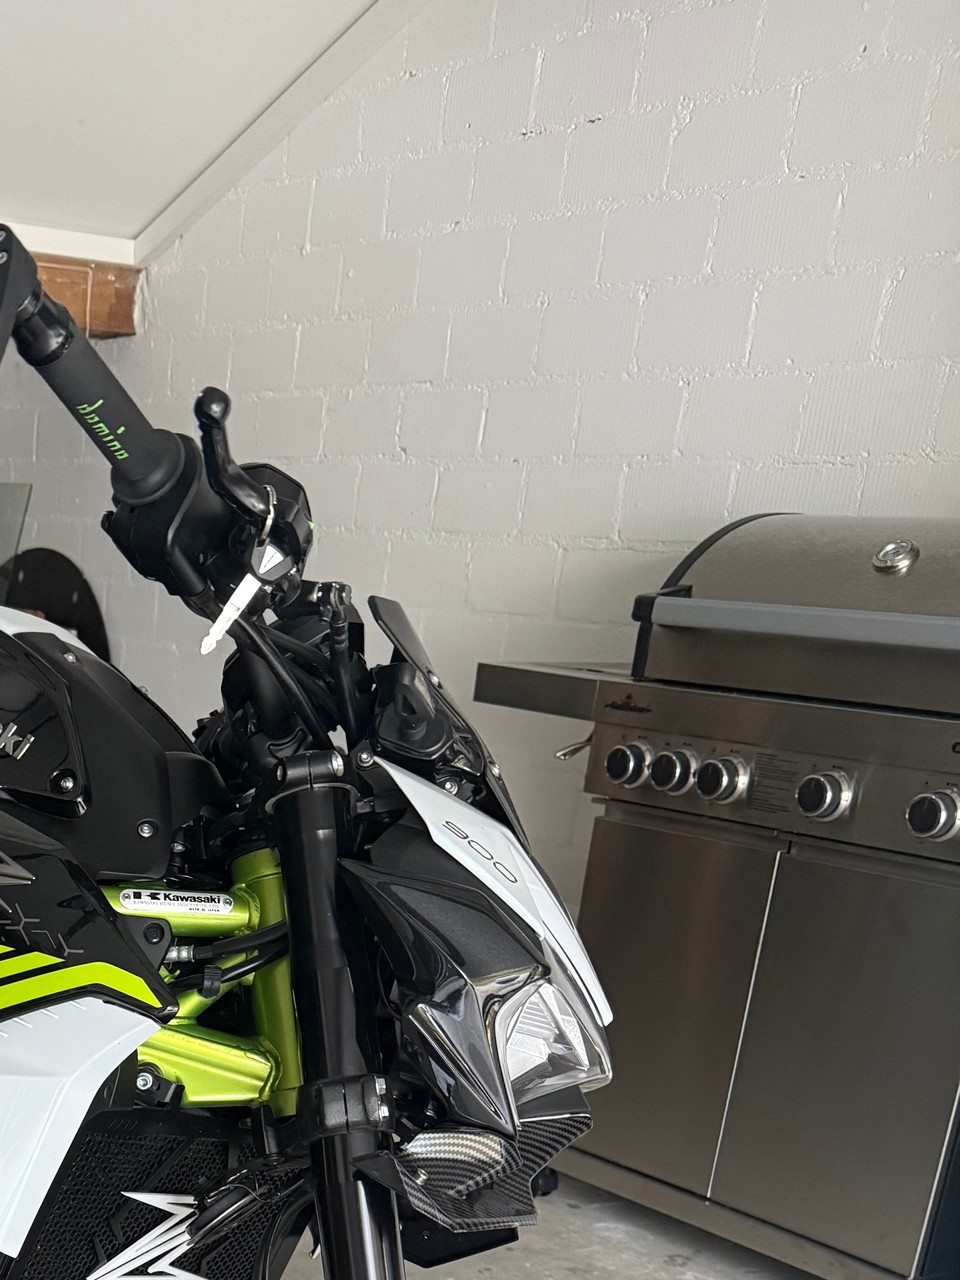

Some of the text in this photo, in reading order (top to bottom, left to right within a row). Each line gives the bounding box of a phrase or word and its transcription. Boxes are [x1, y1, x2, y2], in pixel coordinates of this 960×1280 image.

[76, 399, 129, 460] domino
[441, 820, 518, 884] 900
[163, 892, 220, 904] Kawasaki
